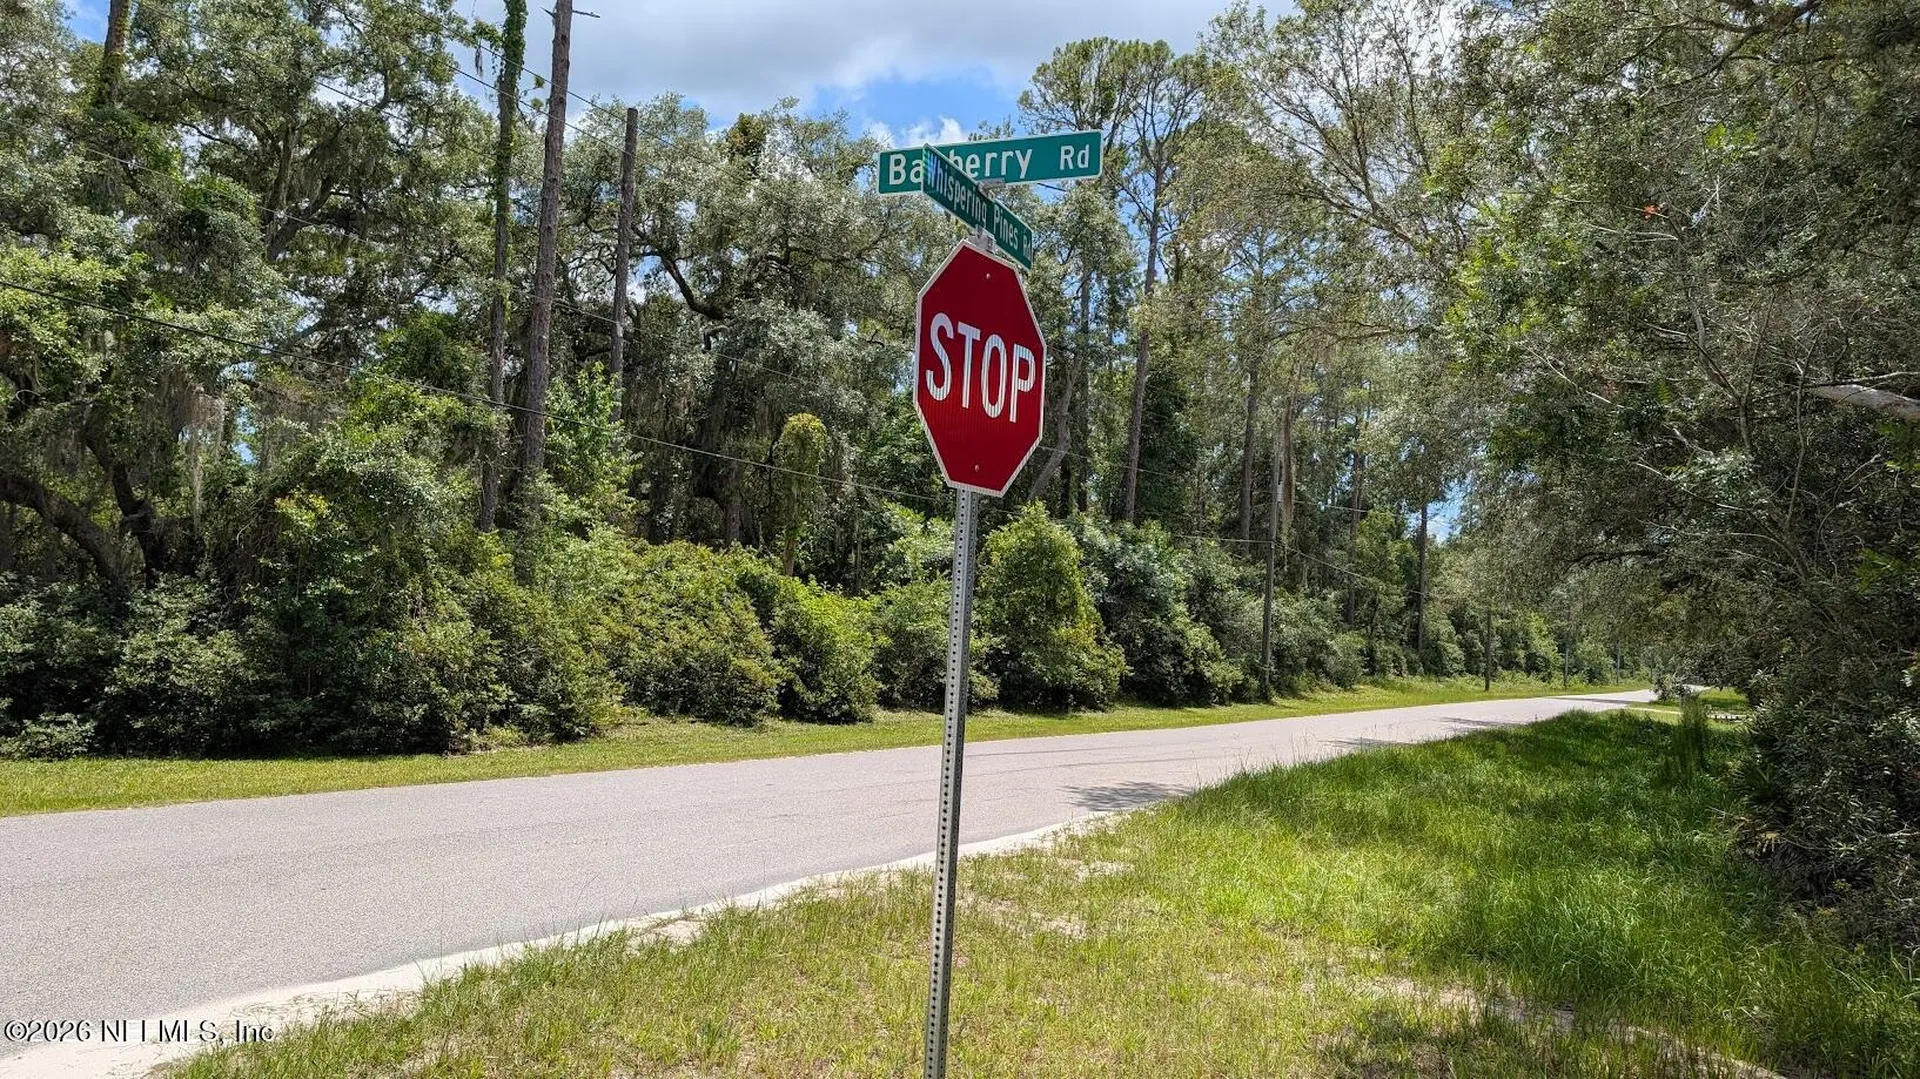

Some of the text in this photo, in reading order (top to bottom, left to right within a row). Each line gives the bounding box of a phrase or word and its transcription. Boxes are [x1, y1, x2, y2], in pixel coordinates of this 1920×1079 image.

[889, 144, 1090, 185] Baberry Rd
[926, 149, 987, 229] Whispering
[993, 204, 1019, 251] Pines
[926, 312, 1036, 423] STOP
